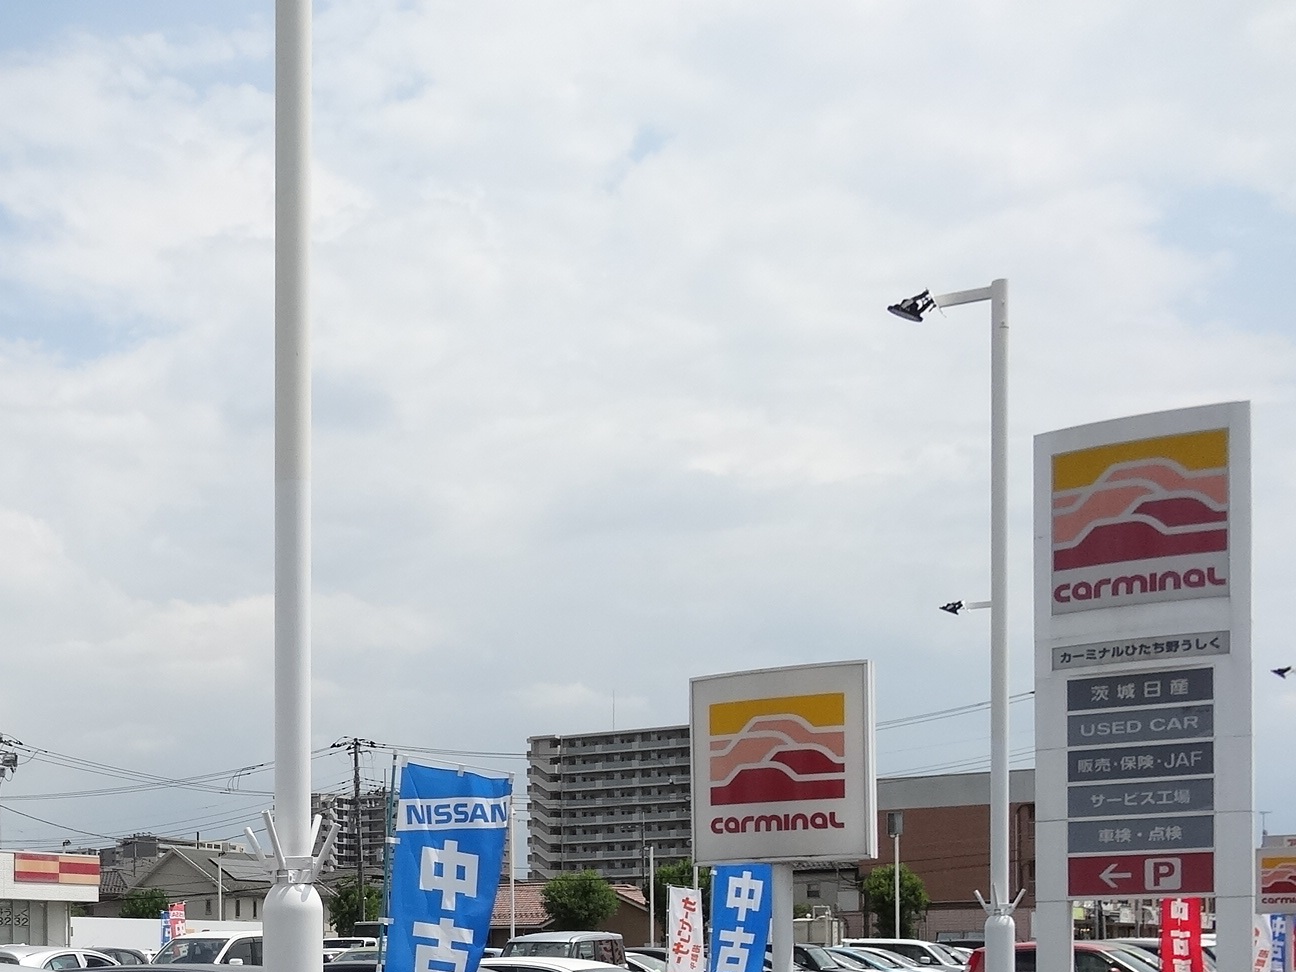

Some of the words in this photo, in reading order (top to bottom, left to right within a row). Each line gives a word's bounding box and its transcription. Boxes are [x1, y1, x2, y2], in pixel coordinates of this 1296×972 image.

[1054, 567, 1226, 603] carminal
[1060, 637, 1221, 664] カーミナルひたち野うしく
[1090, 678, 1190, 702] 茨城日産
[1080, 720, 1142, 737] USED
[1149, 716, 1199, 731] CAR
[1090, 789, 1191, 808] サービス工場
[406, 801, 508, 825] NISSAN
[710, 811, 845, 834] carminal
[1098, 825, 1183, 844] 車検・点検
[1153, 861, 1175, 886] P
